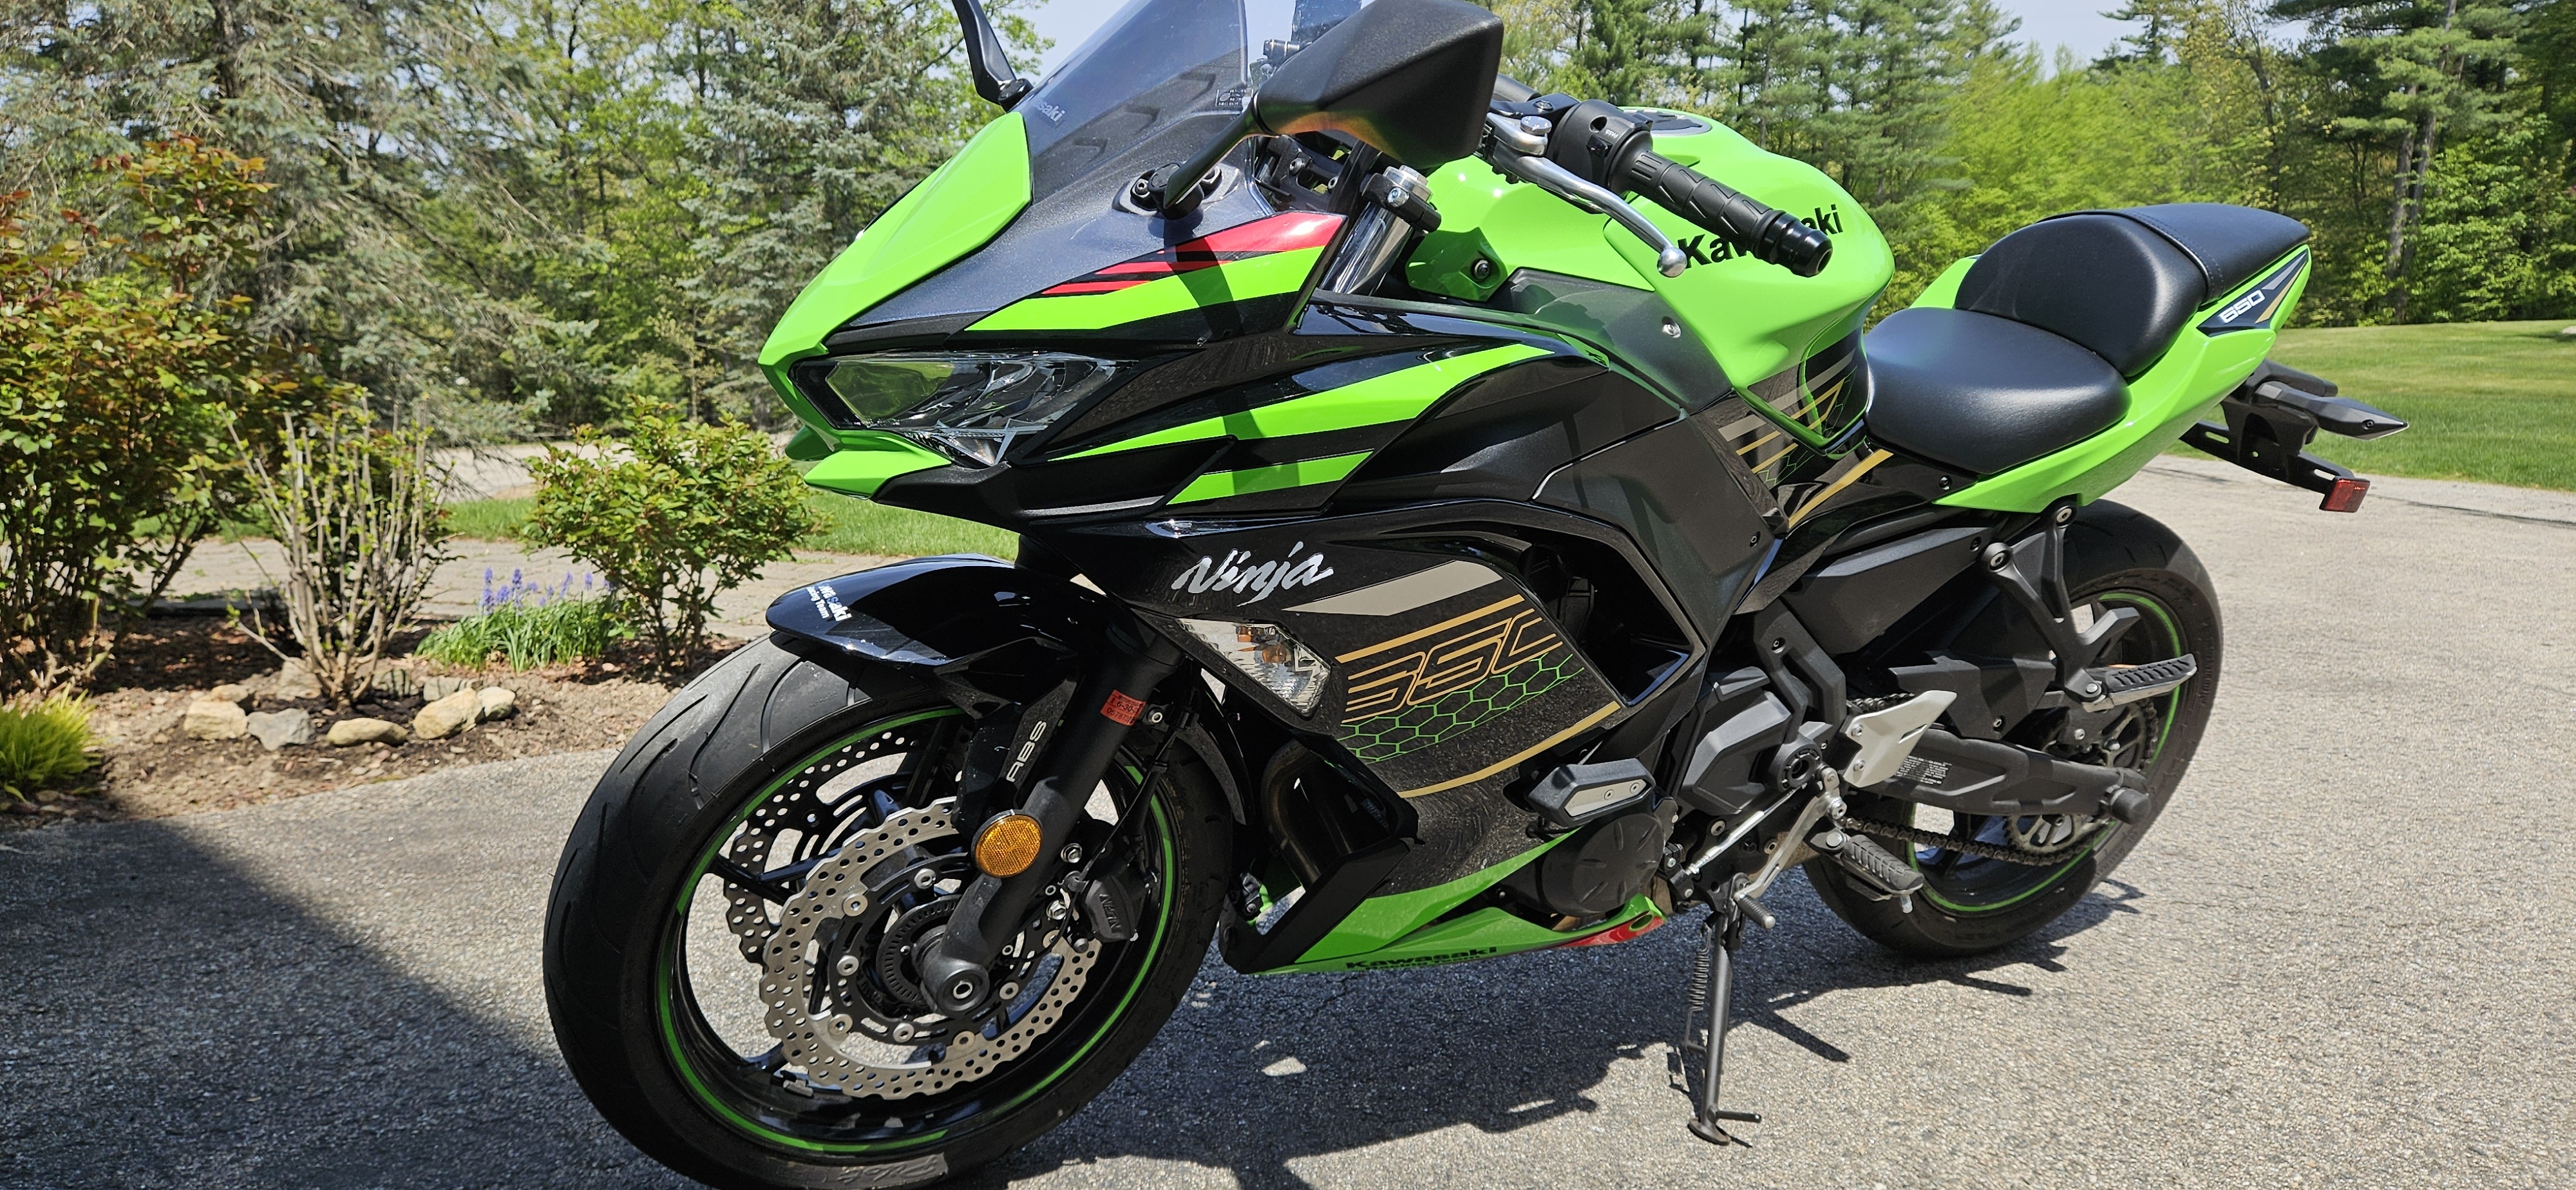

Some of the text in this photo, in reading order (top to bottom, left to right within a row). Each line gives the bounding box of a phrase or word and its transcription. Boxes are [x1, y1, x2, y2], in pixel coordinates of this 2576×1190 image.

[1036, 99, 1066, 122] asaki
[1677, 203, 1844, 269] Kaaki
[2217, 289, 2266, 323] 650
[1171, 541, 1334, 607] Ninja
[815, 599, 829, 619] Team
[817, 583, 852, 621] wasaki
[1006, 721, 1047, 782] ABS
